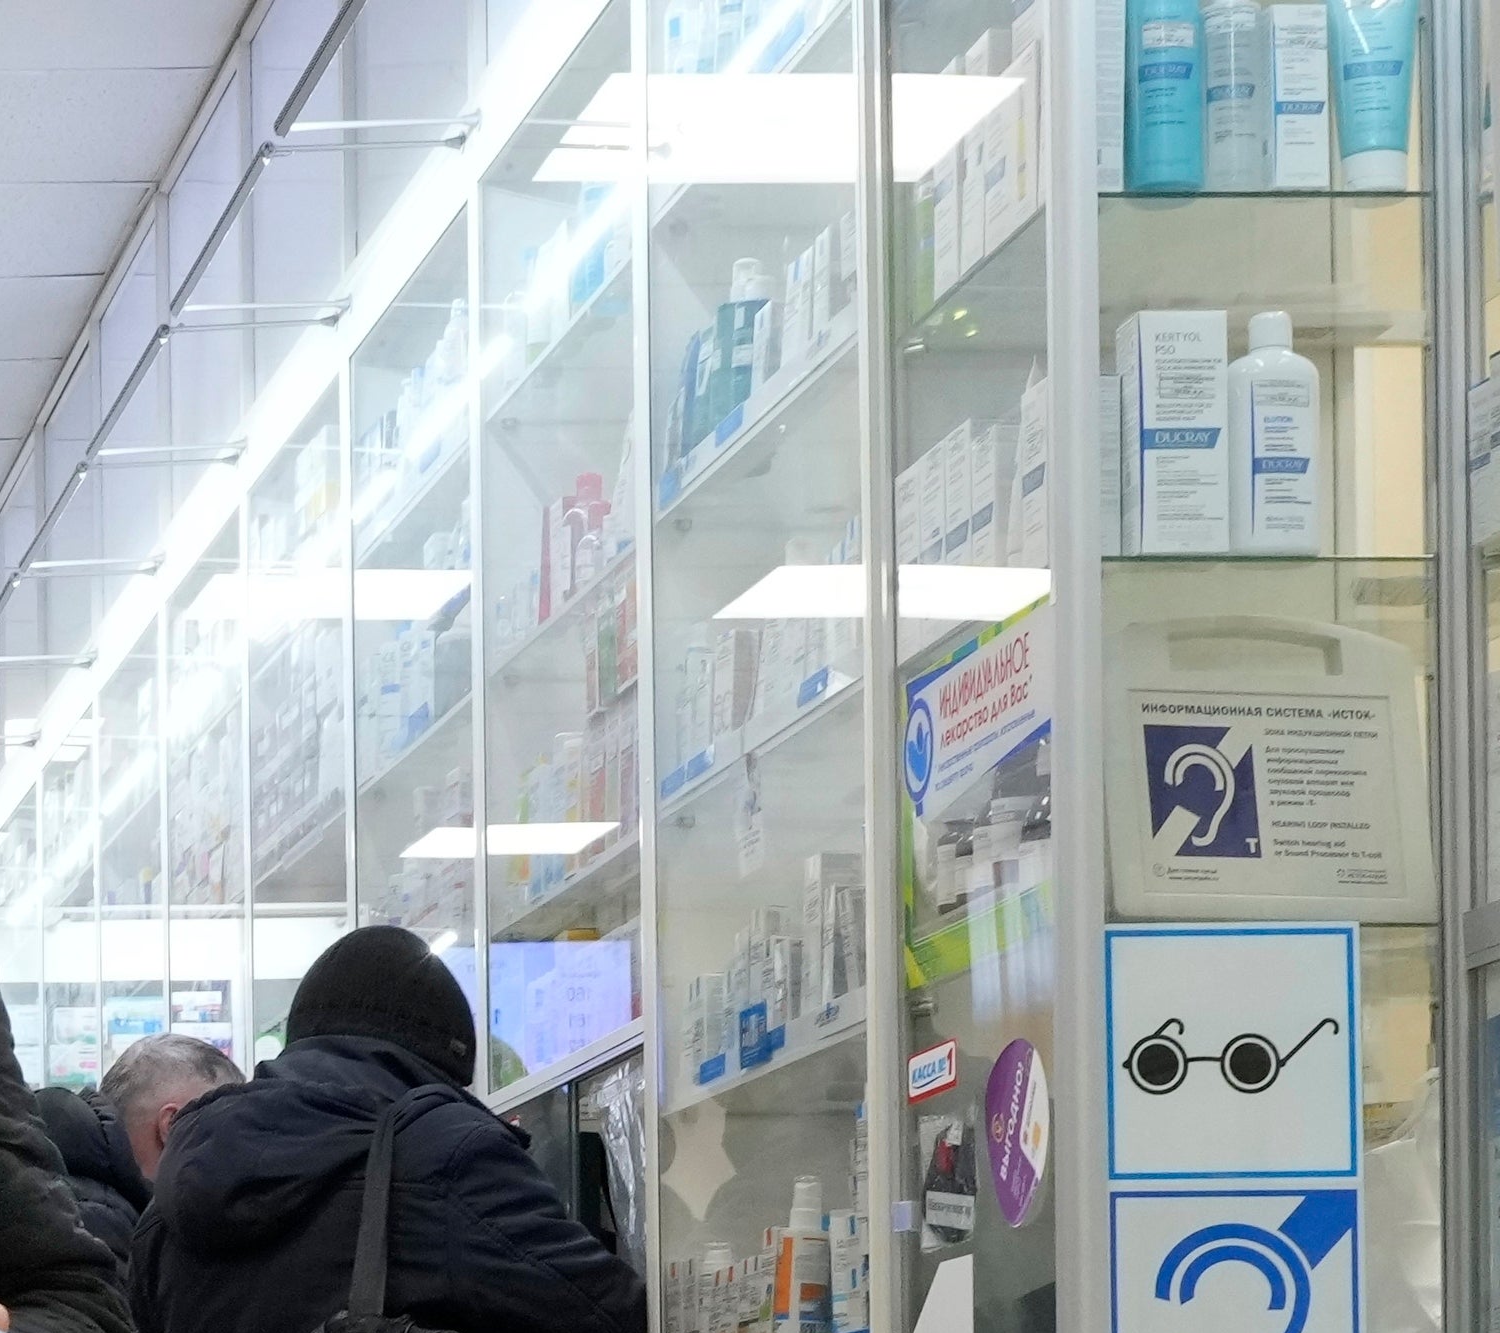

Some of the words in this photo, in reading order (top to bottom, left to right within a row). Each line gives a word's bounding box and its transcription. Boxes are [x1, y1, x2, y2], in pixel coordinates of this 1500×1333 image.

[1155, 431, 1212, 443] DUCRAY
[1262, 459, 1304, 470] DUCRAY
[938, 631, 1030, 720] ИНДИВИДУАЛЬНОЕ
[1141, 703, 1262, 717] ИНФОРМАЦИОННАЯ
[1266, 707, 1323, 719] СИСТЕМА
[940, 707, 989, 750] лекарство
[990, 693, 1009, 724] для
[1245, 838, 1258, 853] T
[912, 1060, 938, 1085] КАССА
[999, 1061, 1024, 1181] ВЫГОДНО!
